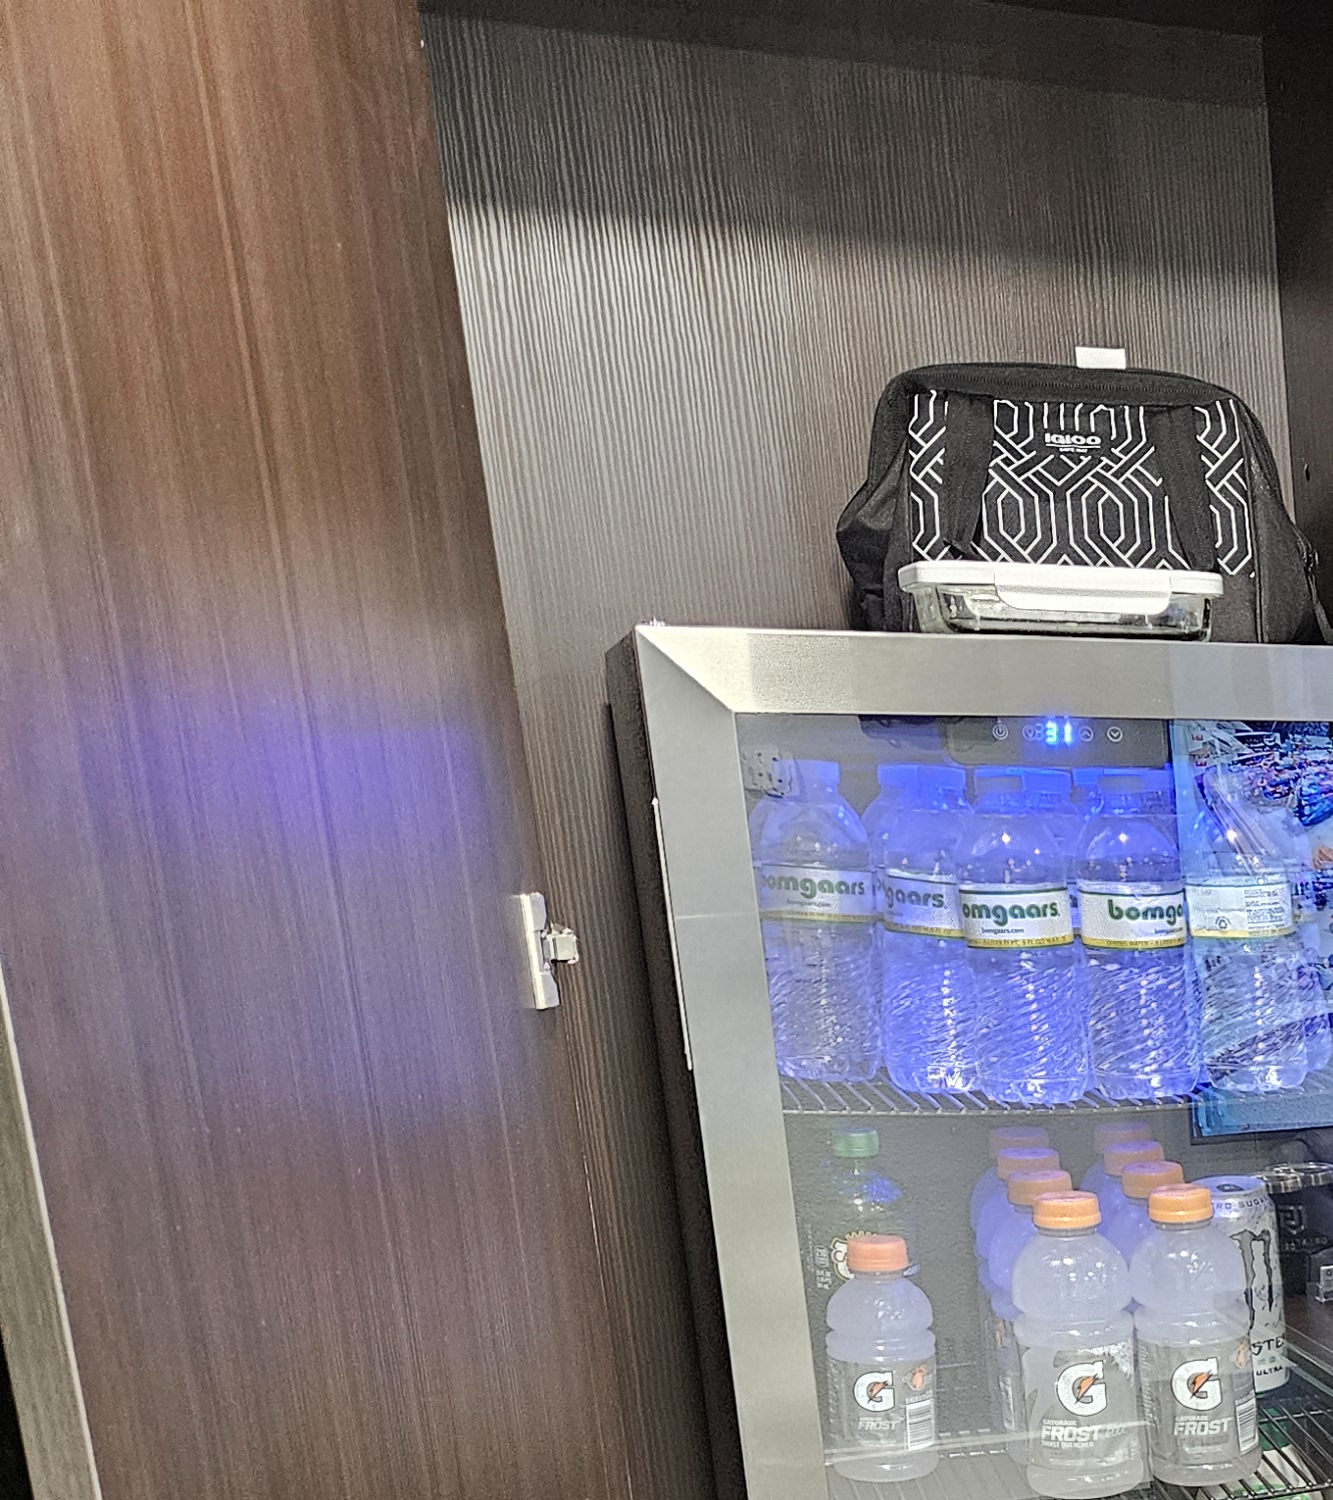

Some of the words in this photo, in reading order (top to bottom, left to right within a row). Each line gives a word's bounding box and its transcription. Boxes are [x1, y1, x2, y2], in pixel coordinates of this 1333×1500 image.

[1044, 432, 1102, 445] IGLOO
[765, 874, 865, 899] omgaars
[962, 900, 1060, 926] omgaars
[1255, 1365, 1284, 1377] ULTRA
[853, 1370, 896, 1413] G
[1055, 1360, 1108, 1418] G
[1170, 1356, 1223, 1412] G
[857, 1419, 899, 1432] FROST
[1040, 1424, 1101, 1442] FROST
[1173, 1416, 1234, 1436] FROST
